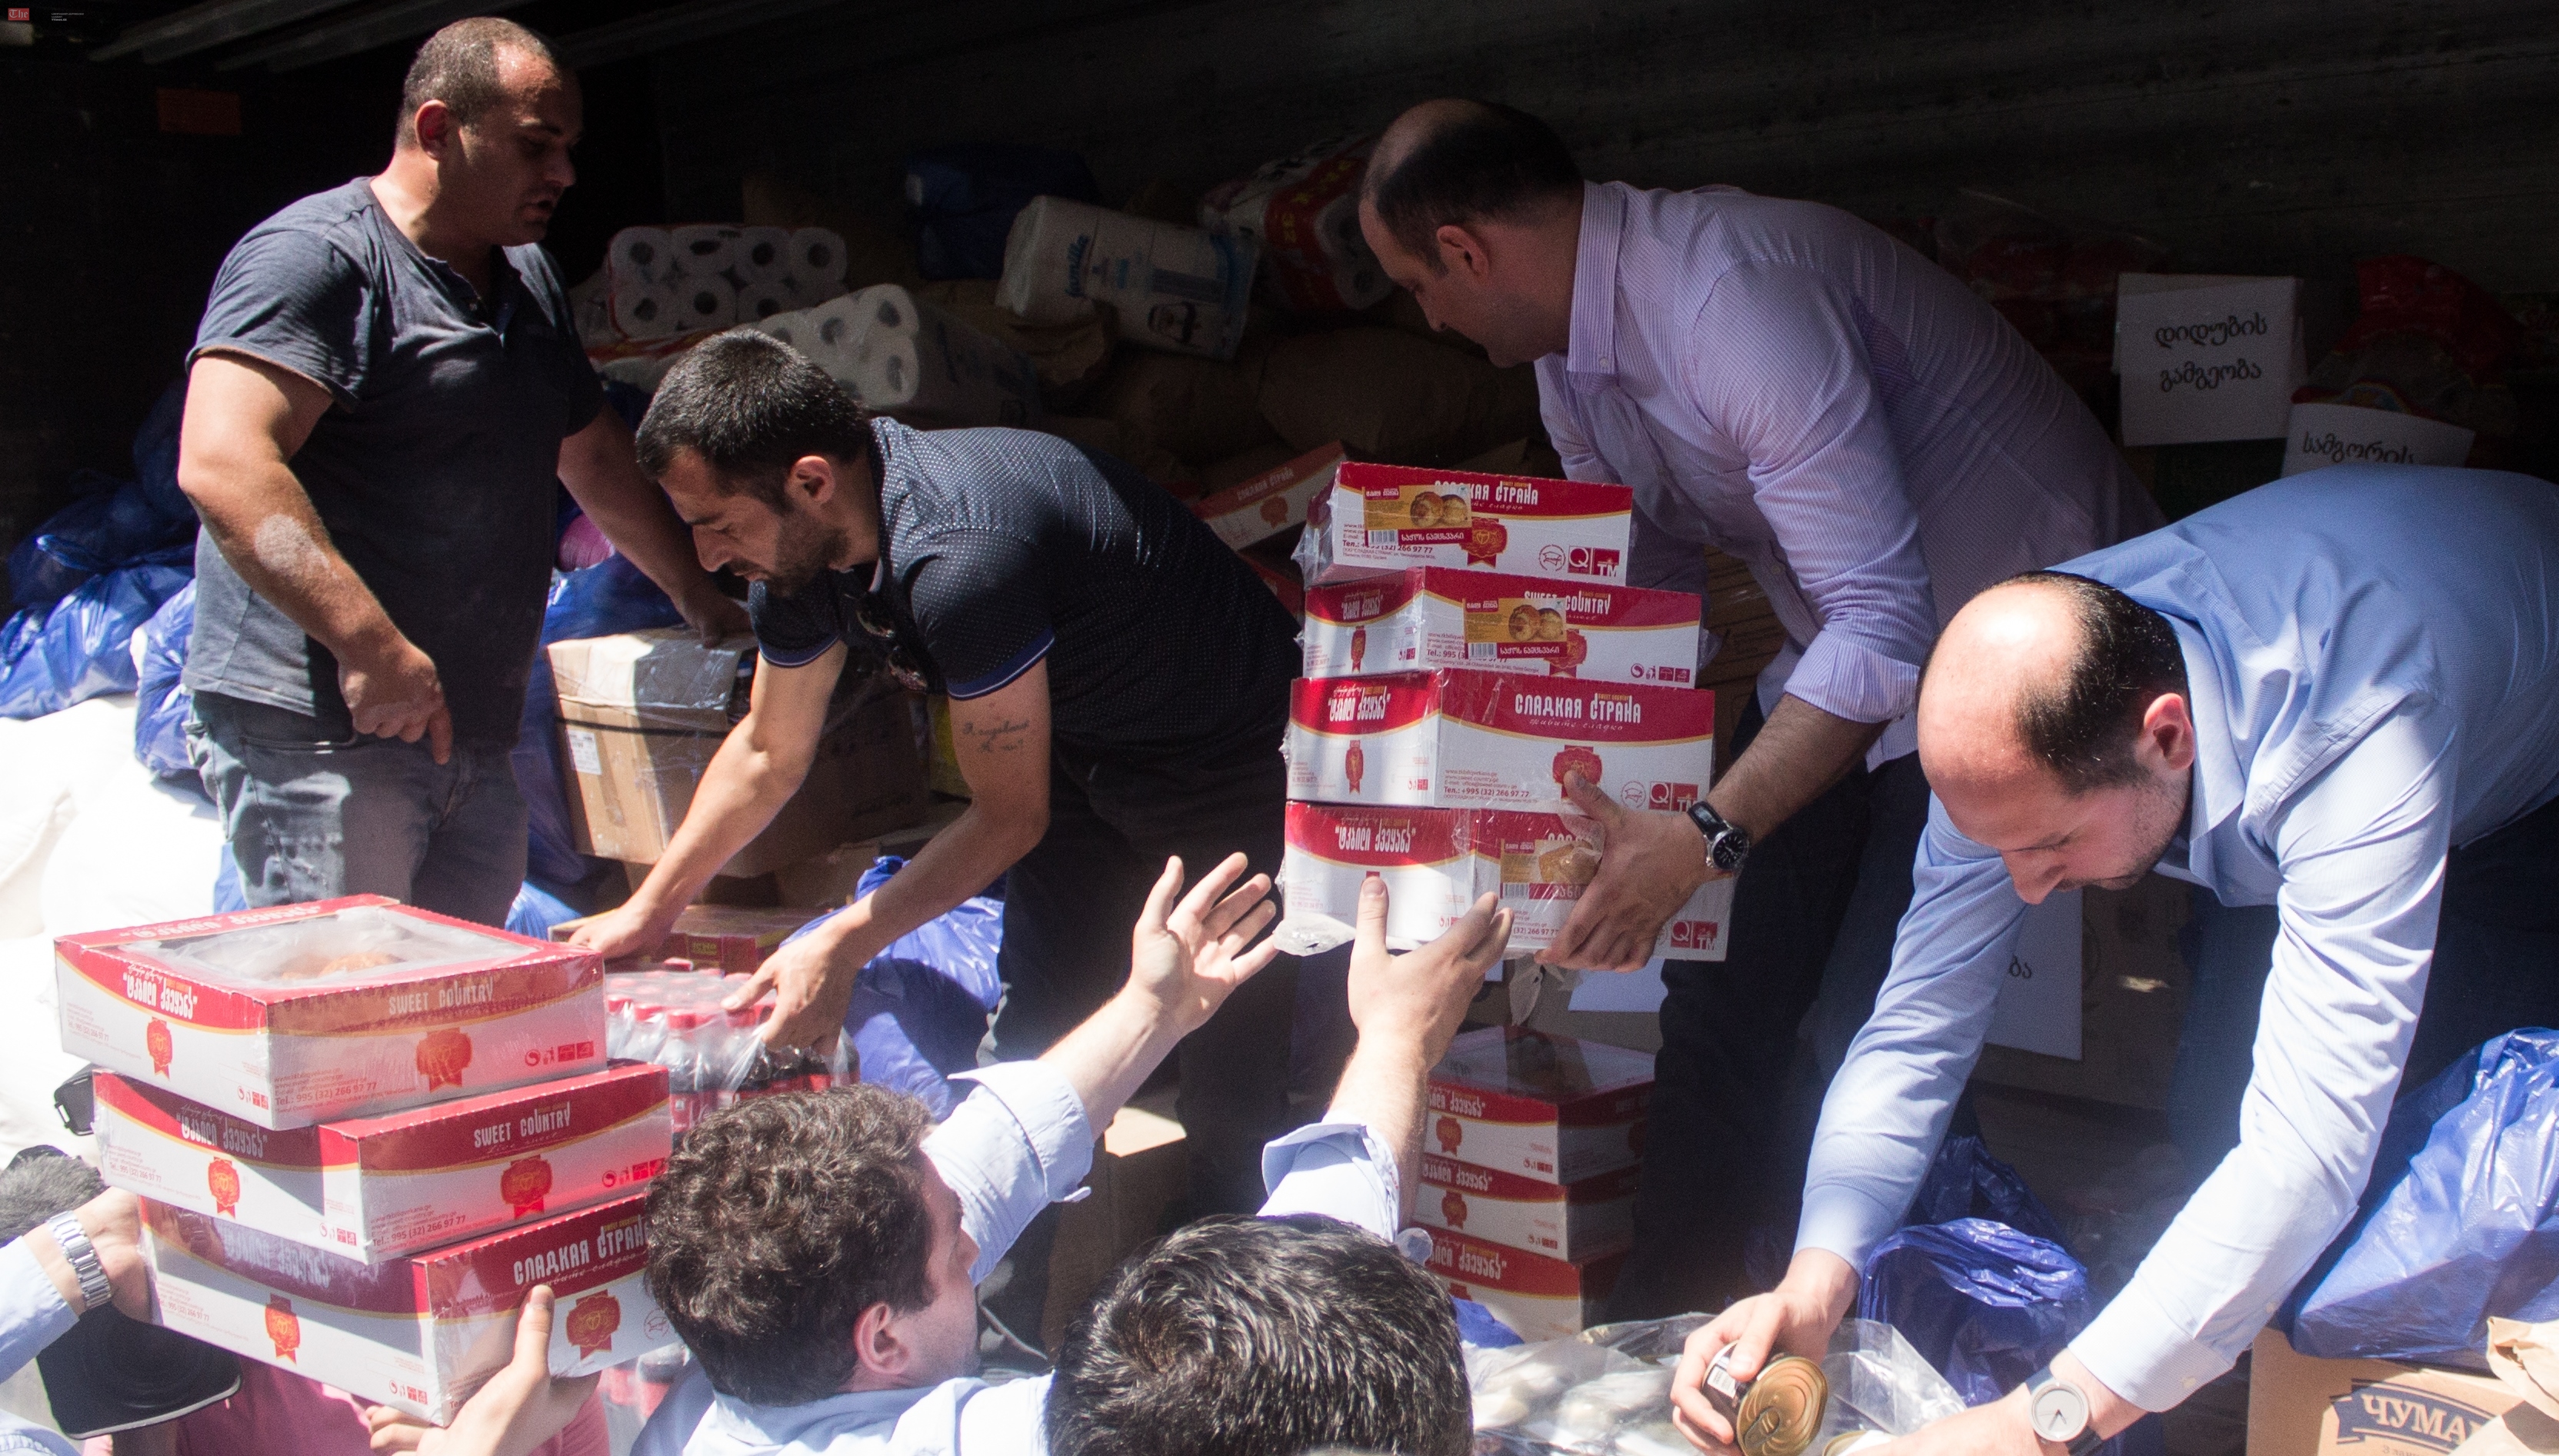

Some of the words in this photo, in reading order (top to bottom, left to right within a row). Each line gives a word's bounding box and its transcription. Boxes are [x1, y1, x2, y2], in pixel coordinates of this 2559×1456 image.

[2155, 311, 2267, 349] დიდუბის
[2160, 358, 2263, 392] გამგეობა
[1496, 480, 1538, 505] СТРАНА
[1565, 591, 1611, 615] COUNTRY
[1515, 694, 1582, 718] СЛАДКАЯ
[1590, 692, 1641, 724] СТРАНА
[1481, 788, 1494, 796] (32)
[1334, 825, 1371, 851] "ტკბილი
[1374, 818, 1416, 853] ქვეყანა"
[123, 972, 157, 1007] "ტკბილი
[160, 977, 198, 1020] ქვეყანა"
[389, 992, 428, 1015] SWEET
[438, 977, 494, 1008] COUNTRY
[275, 1097, 293, 1105] Tel.:
[296, 1093, 313, 1103] 995
[315, 1089, 333, 1101] (32)
[335, 1086, 352, 1096] 266
[353, 1083, 365, 1091] 97
[367, 1081, 378, 1091] 77
[176, 1114, 218, 1146] "ტკბილი
[222, 1117, 268, 1158] ქვეყანა"
[474, 1122, 511, 1148] SWEET
[520, 1101, 571, 1138] COUNTRY
[372, 1238, 390, 1247] Tel.:
[392, 1231, 407, 1241] 995
[408, 1226, 425, 1238] (32)
[427, 1221, 442, 1232] 266
[444, 1218, 454, 1227] 97
[455, 1214, 466, 1224] 77
[513, 1239, 590, 1285] СЛАДКАЯ
